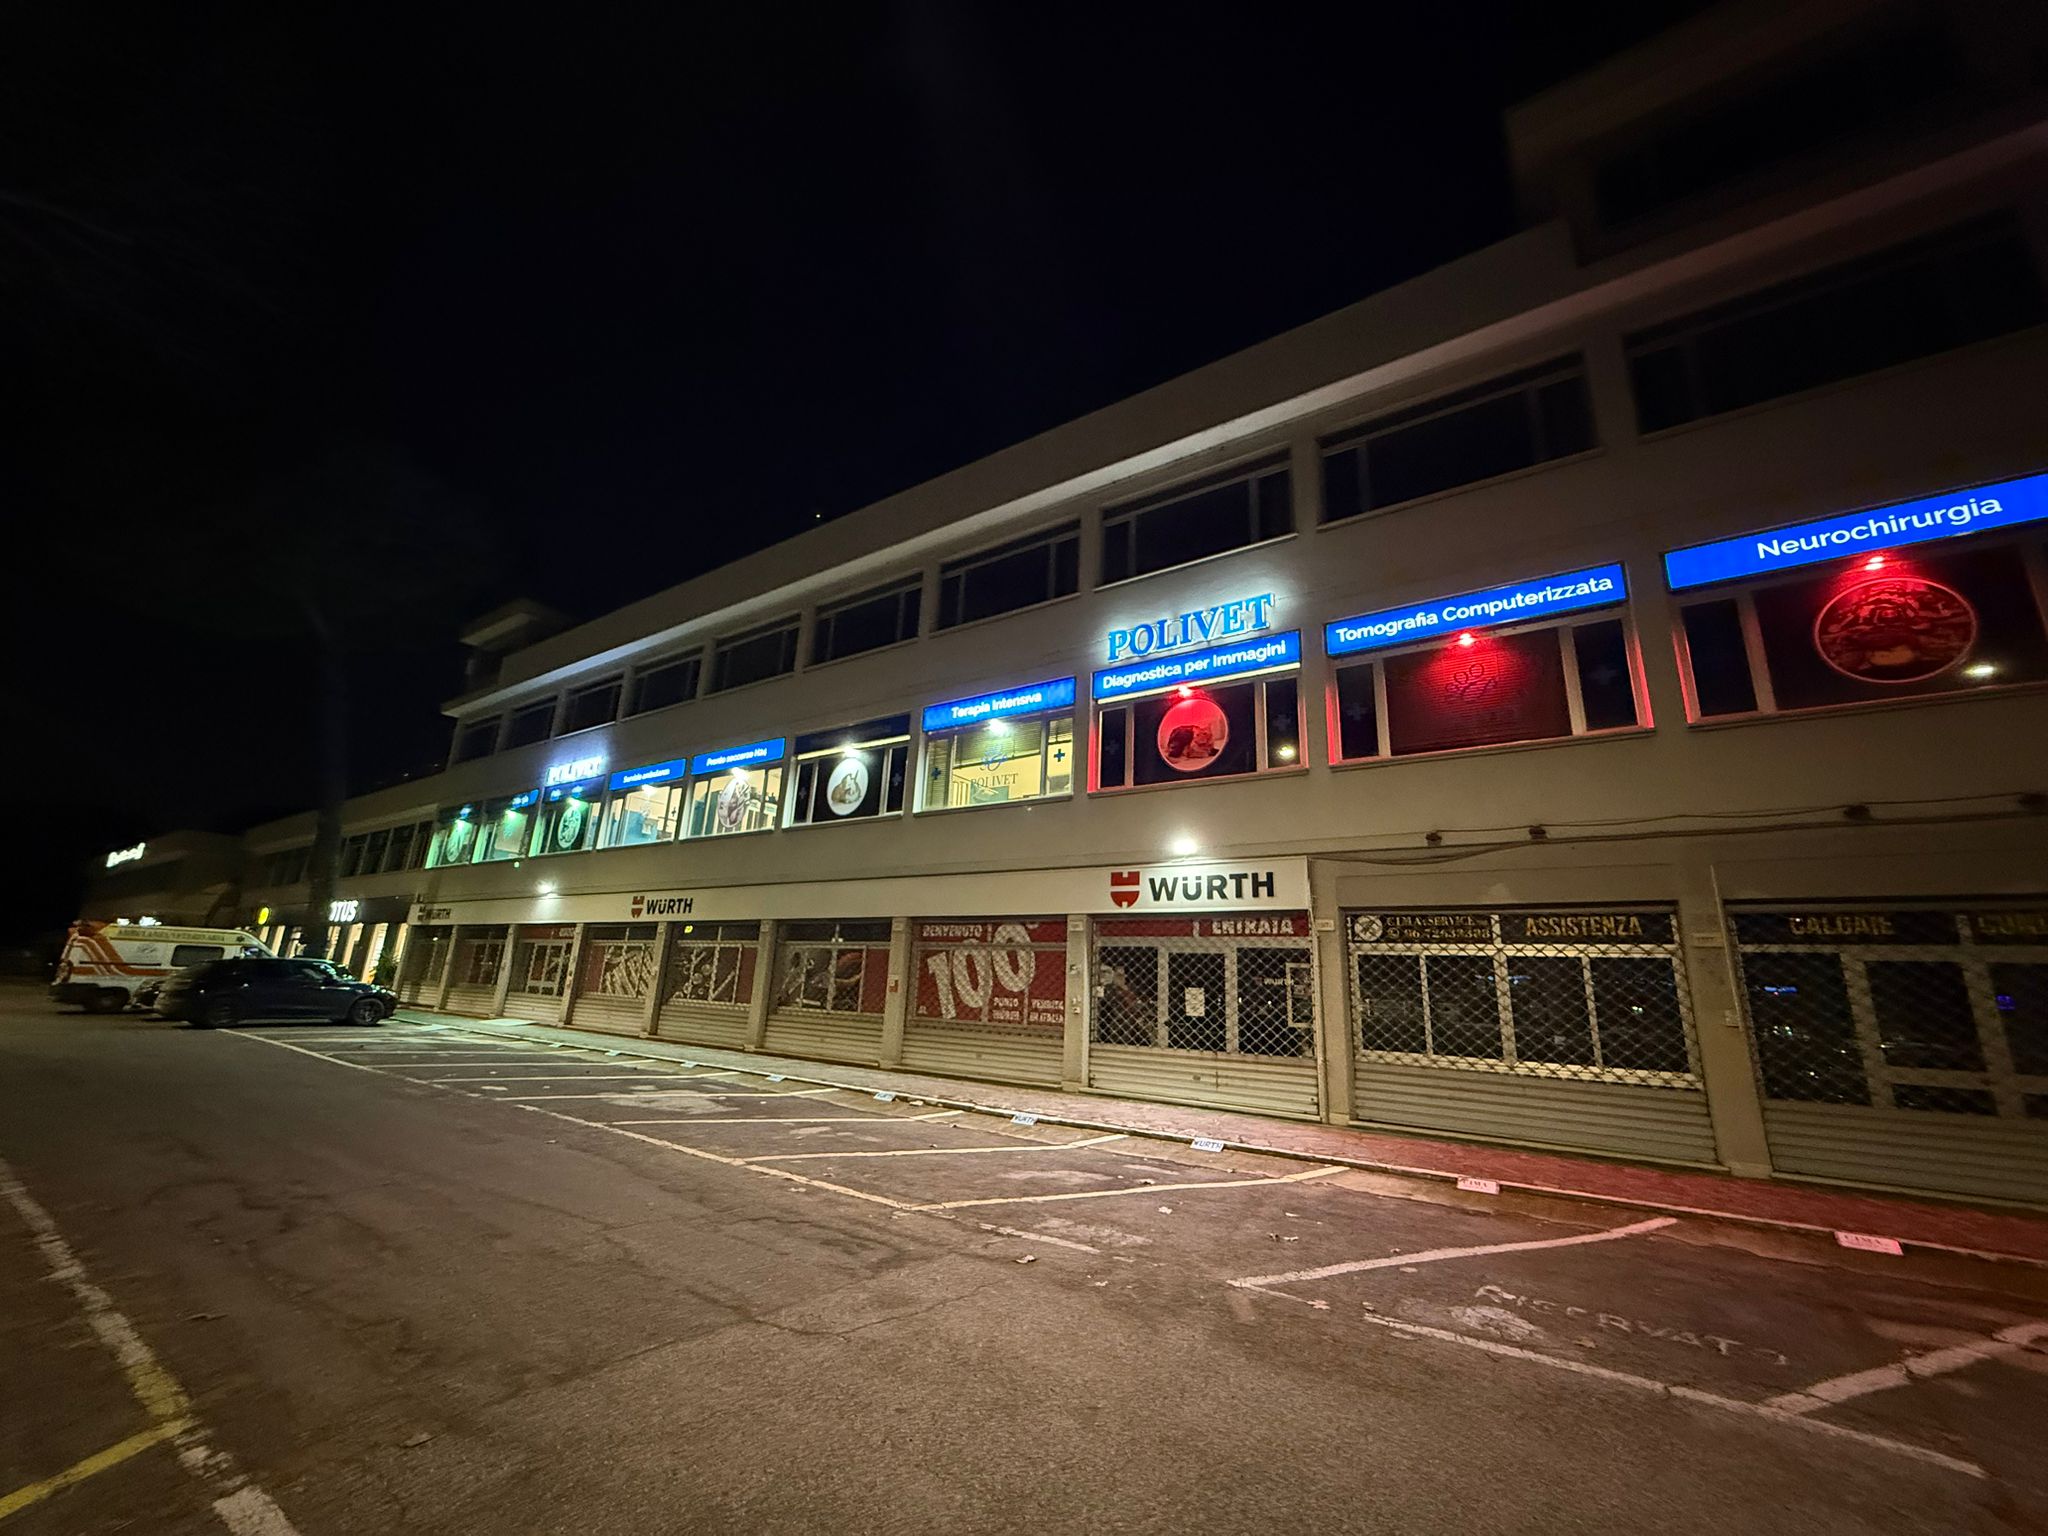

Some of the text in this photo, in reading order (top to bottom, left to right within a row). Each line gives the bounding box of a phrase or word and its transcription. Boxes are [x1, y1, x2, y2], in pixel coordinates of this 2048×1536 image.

[1757, 498, 2003, 559] Neurochirurgia
[1336, 576, 1613, 643] Tomografia Computerizzata
[1108, 592, 1275, 663] POLIVET
[1102, 639, 1286, 689] Diagnostica per Immagini
[951, 691, 1043, 719] Terapia Intensiva
[971, 773, 1018, 788] POLIVET
[1149, 871, 1275, 902] WÜRTH
[646, 897, 694, 915] WÜRTH
[922, 923, 983, 938] BENVENUTO
[1211, 918, 1295, 935] ENTRATA
[1525, 916, 1643, 937] ASSISTENZA
